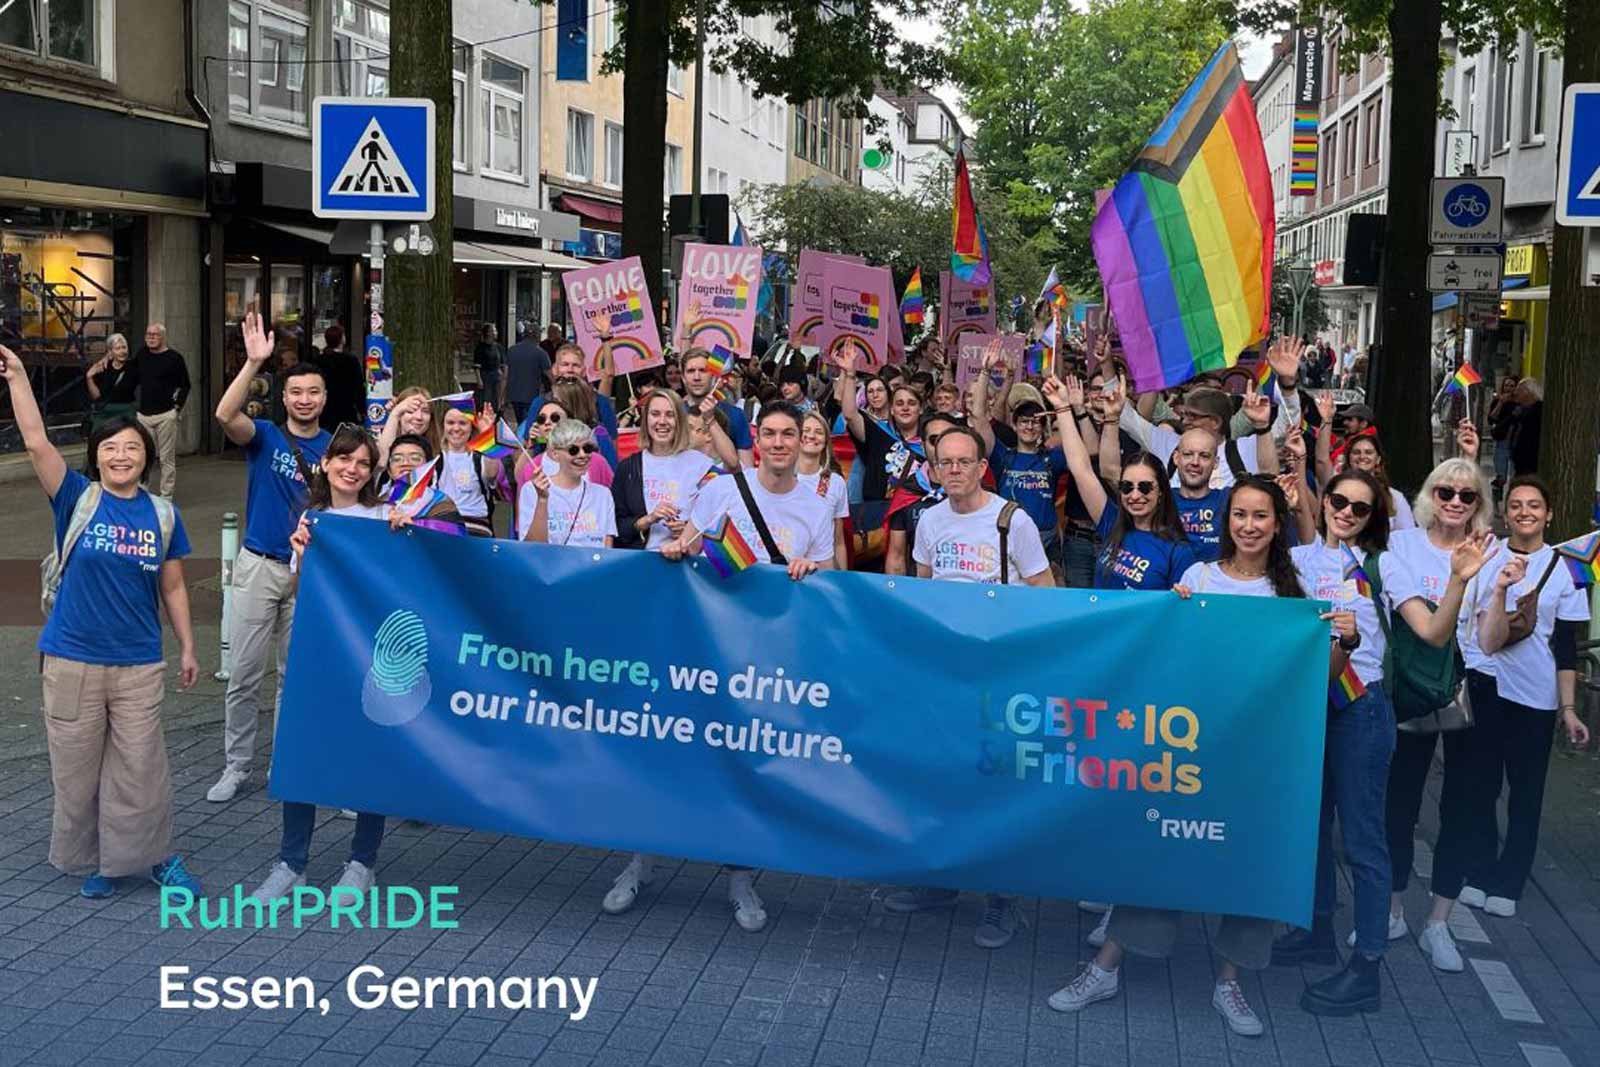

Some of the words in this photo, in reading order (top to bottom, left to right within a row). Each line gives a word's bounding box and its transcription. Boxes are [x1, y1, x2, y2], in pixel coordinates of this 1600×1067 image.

[1303, 41, 1315, 101] Mayersche
[570, 266, 643, 306] COME
[687, 249, 759, 282] LOVE
[1473, 267, 1493, 278] frei
[94, 537, 157, 558] Friends
[457, 633, 553, 677] From
[563, 648, 660, 693] here,
[669, 664, 718, 695] we
[728, 665, 831, 709] drive
[450, 689, 520, 722] our
[524, 689, 696, 744] inclusive
[703, 718, 853, 765] culture.
[1015, 740, 1203, 796] Friends
